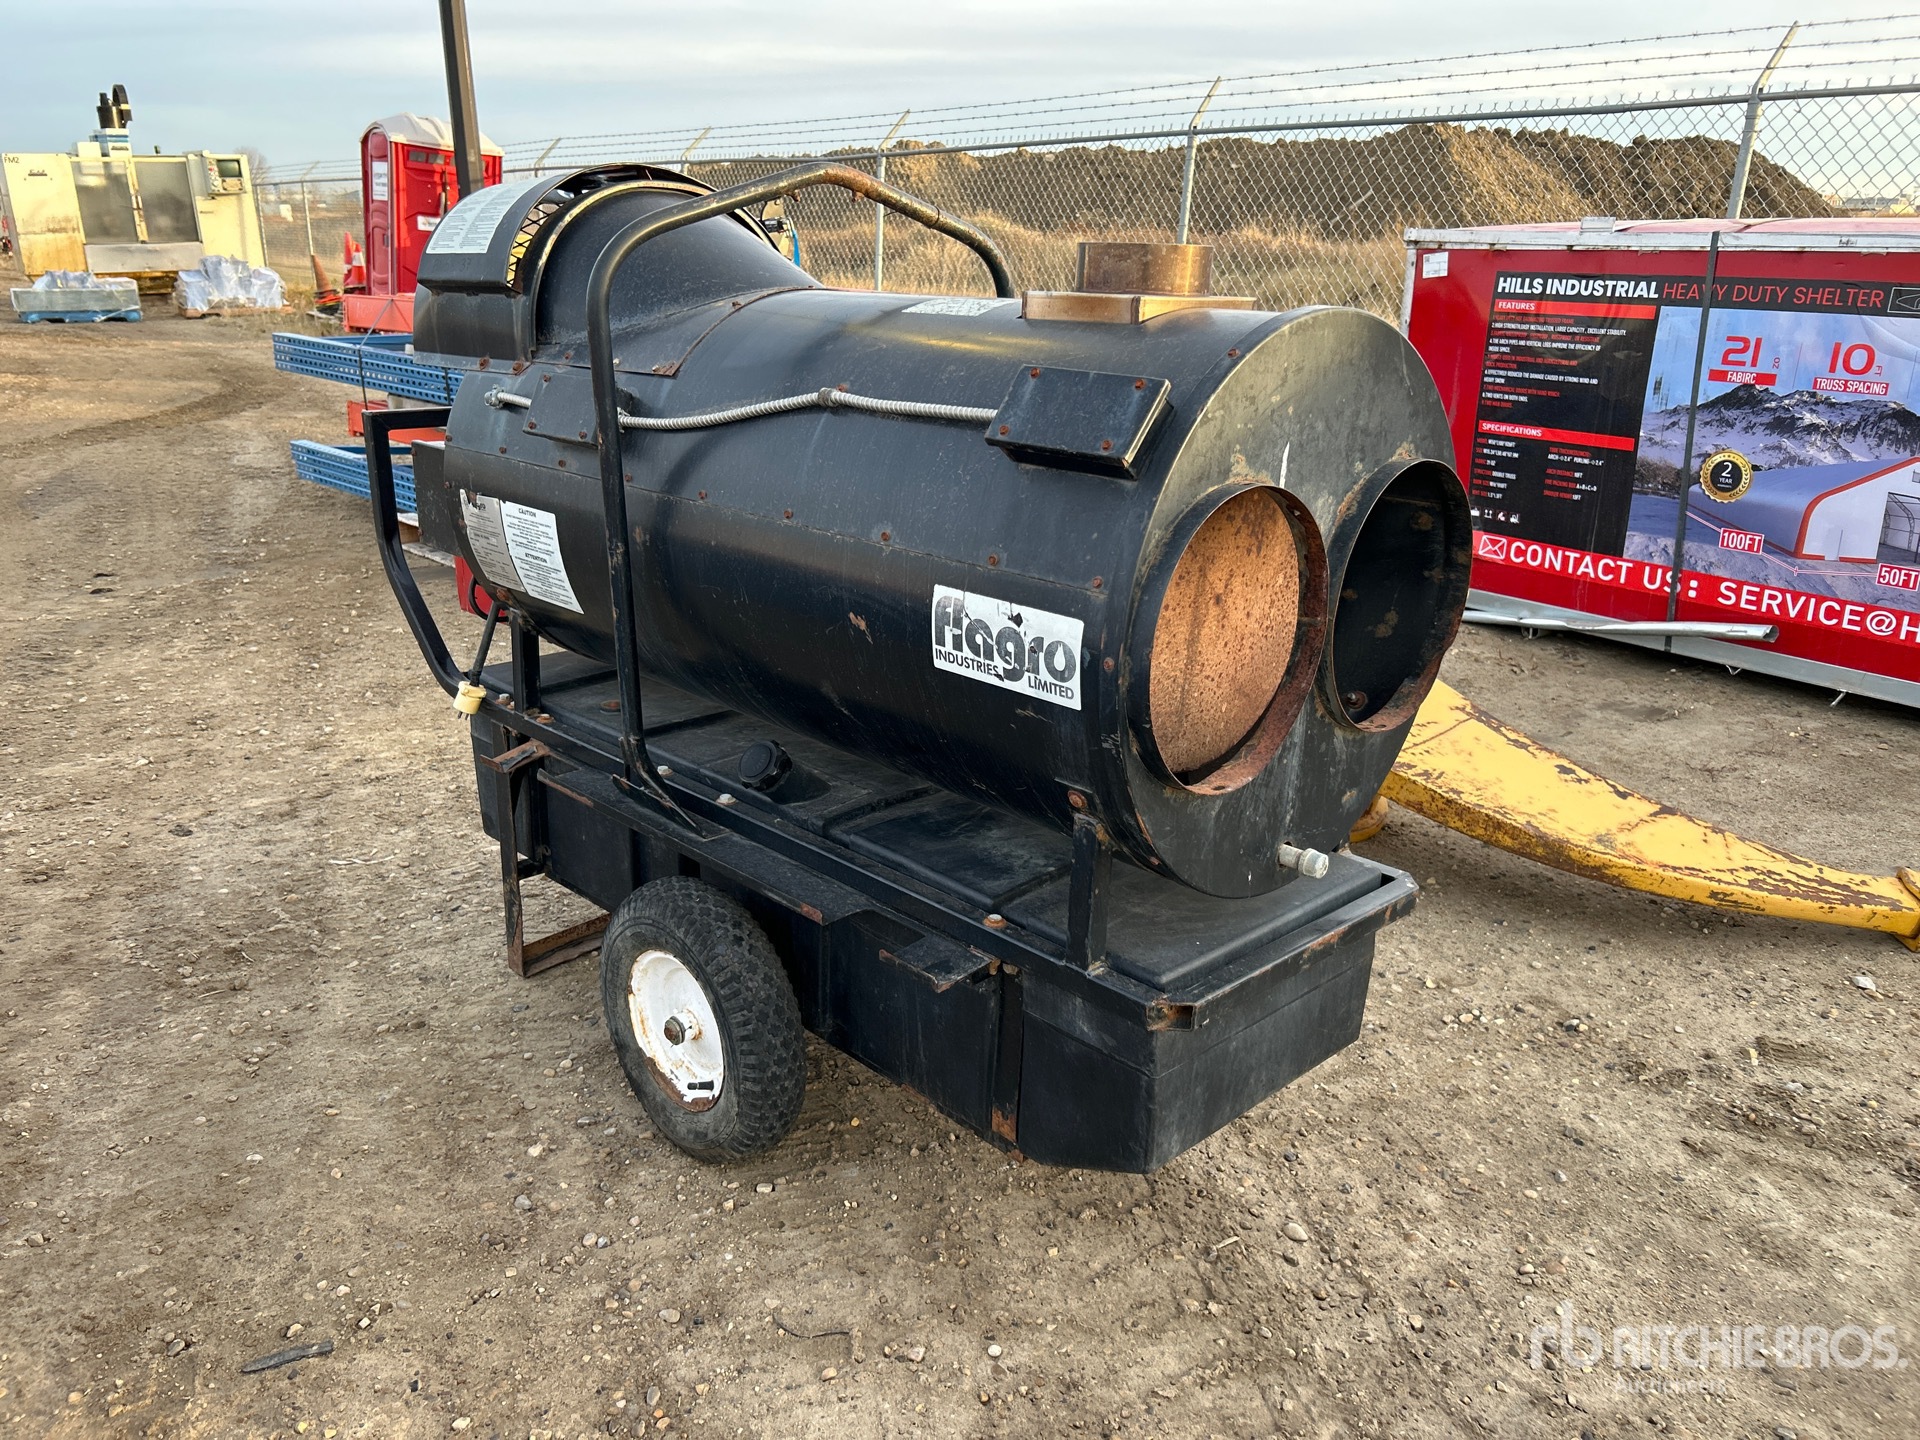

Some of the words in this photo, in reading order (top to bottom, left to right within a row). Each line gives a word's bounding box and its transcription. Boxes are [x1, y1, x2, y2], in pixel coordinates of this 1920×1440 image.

[1497, 277, 1543, 294] HILLS
[1546, 278, 1659, 298] INDUSTRIAL
[1733, 284, 1789, 304] DUTY
[1793, 286, 1885, 308] SHELTER
[1498, 301, 1535, 311] FEATURES
[1720, 335, 1763, 368] 21
[1772, 357, 1780, 369] OZ
[1828, 342, 1876, 376] 10
[1874, 365, 1883, 377] FT
[1727, 372, 1757, 384] FABIRC
[1816, 378, 1844, 391] TRUSS
[1846, 380, 1887, 395] SPACING
[1482, 422, 1543, 437] SPECIFICATIONS
[1721, 461, 1733, 478] 2
[518, 507, 537, 518] CAUTION
[1722, 531, 1762, 552] 100FT
[1879, 567, 1919, 589] 50FT
[1509, 541, 1634, 584] CONTACT
[1717, 581, 1920, 644] SERVICE@H
[934, 646, 1000, 678] INDUSTRIES
[1027, 674, 1075, 701] LIMITED
